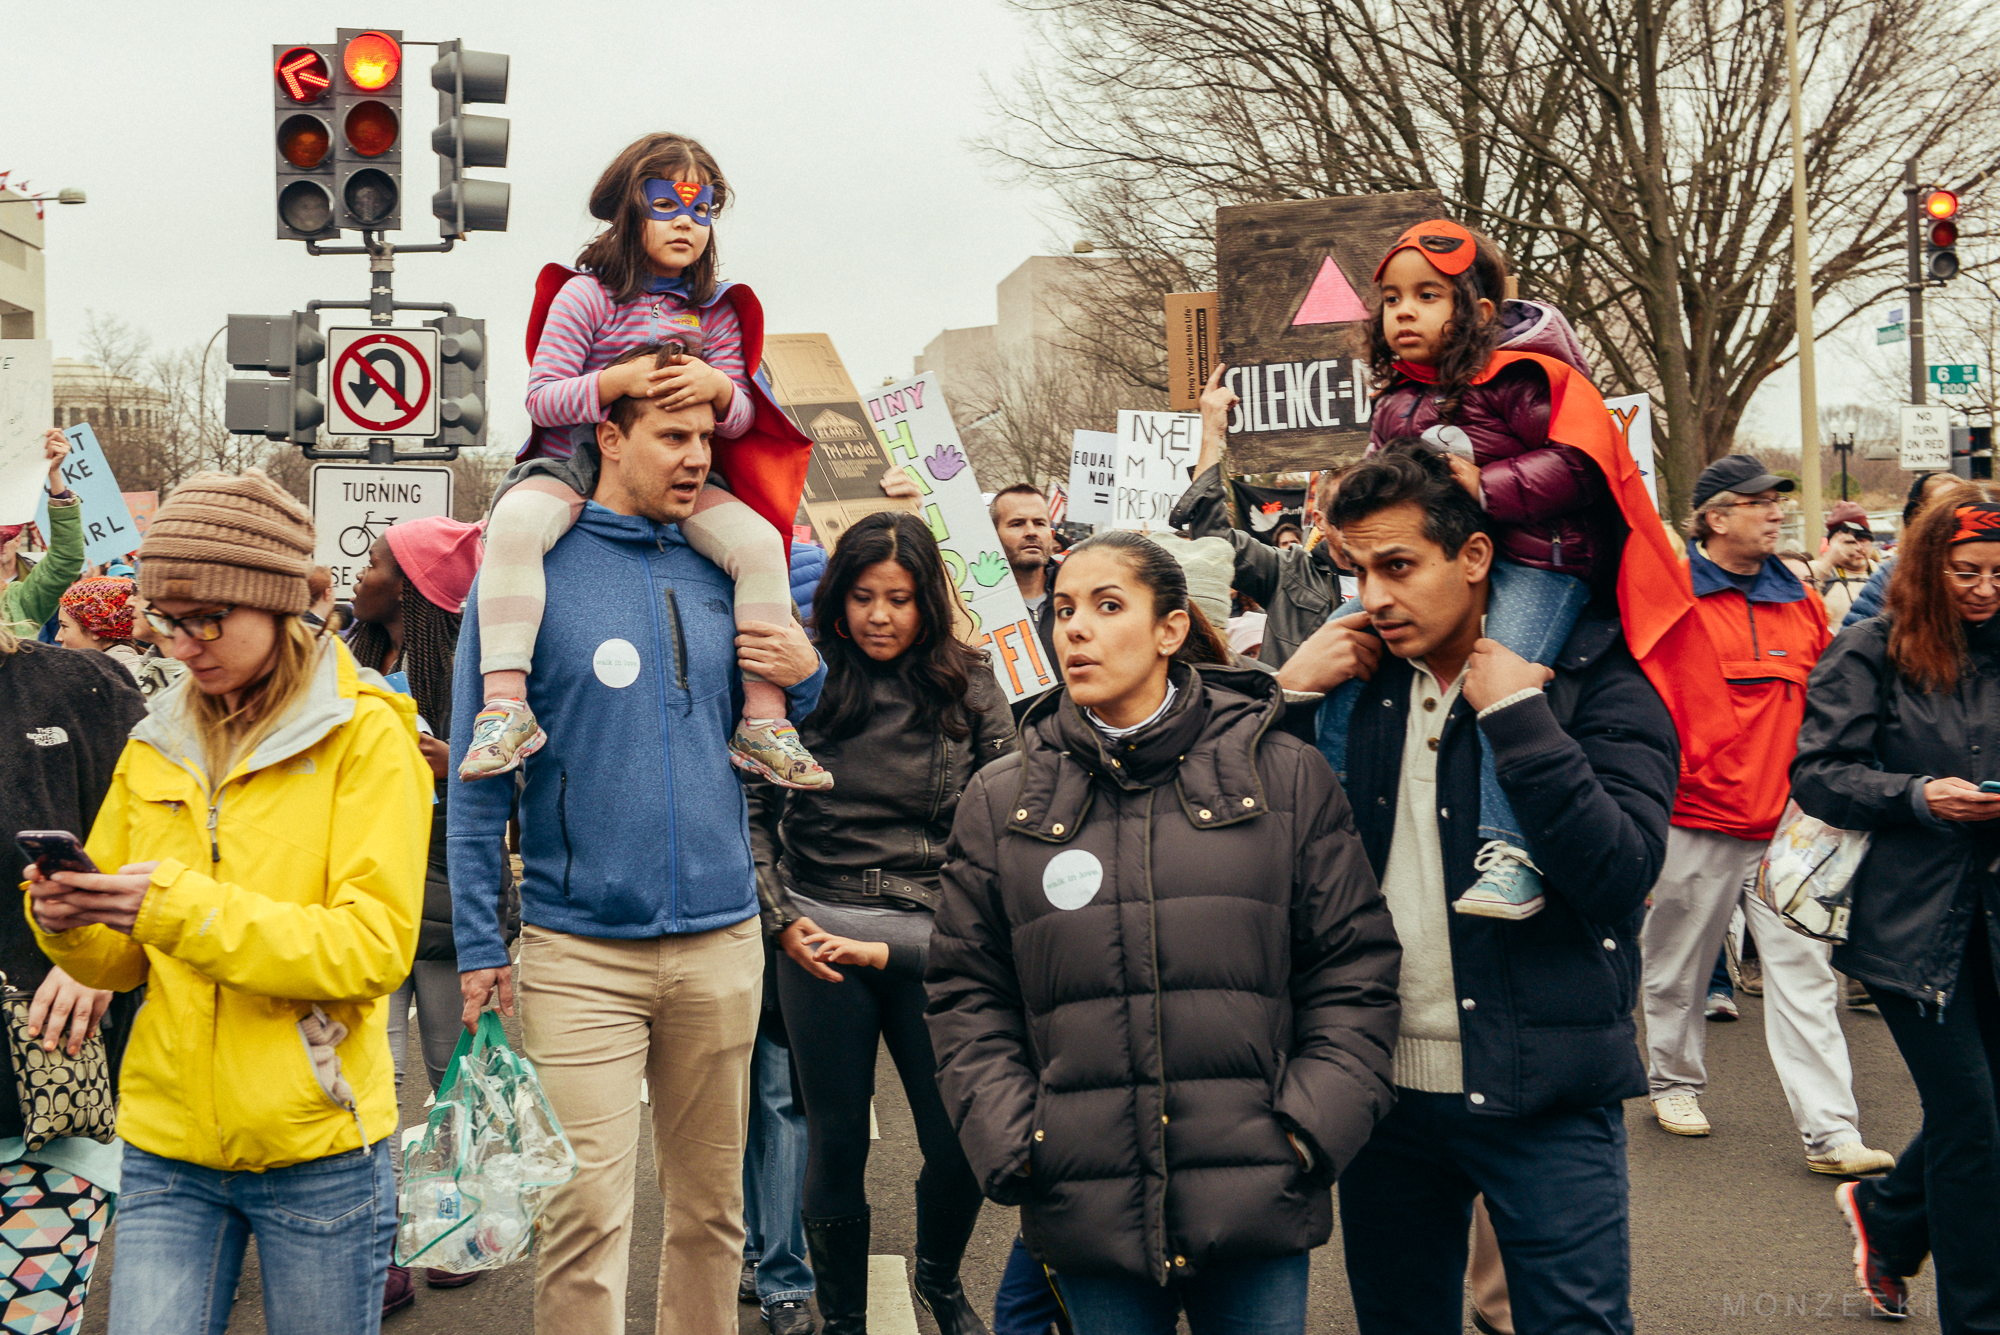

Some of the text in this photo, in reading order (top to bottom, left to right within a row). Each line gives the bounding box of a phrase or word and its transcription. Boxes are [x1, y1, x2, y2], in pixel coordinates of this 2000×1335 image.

[1185, 325, 1193, 333] to
[1185, 334, 1194, 356] Ideas
[1199, 312, 1207, 383] www.elmers.com
[1186, 357, 1195, 377] Your
[1936, 367, 1950, 382] 6
[1187, 378, 1196, 400] Bring
[1941, 384, 1967, 394] 200
[868, 381, 925, 422] INY
[1916, 412, 1932, 421] NO
[1132, 414, 1200, 460] NYET
[1912, 426, 1938, 435] TURN
[819, 441, 878, 459] Tri-Fold
[1906, 440, 1945, 449] ON RED
[1073, 450, 1114, 469] EQUAL
[1902, 454, 1950, 463] 7AM-7PM
[1088, 471, 1115, 487] NOW
[342, 482, 421, 504] TURNING
[330, 566, 351, 585] SE
